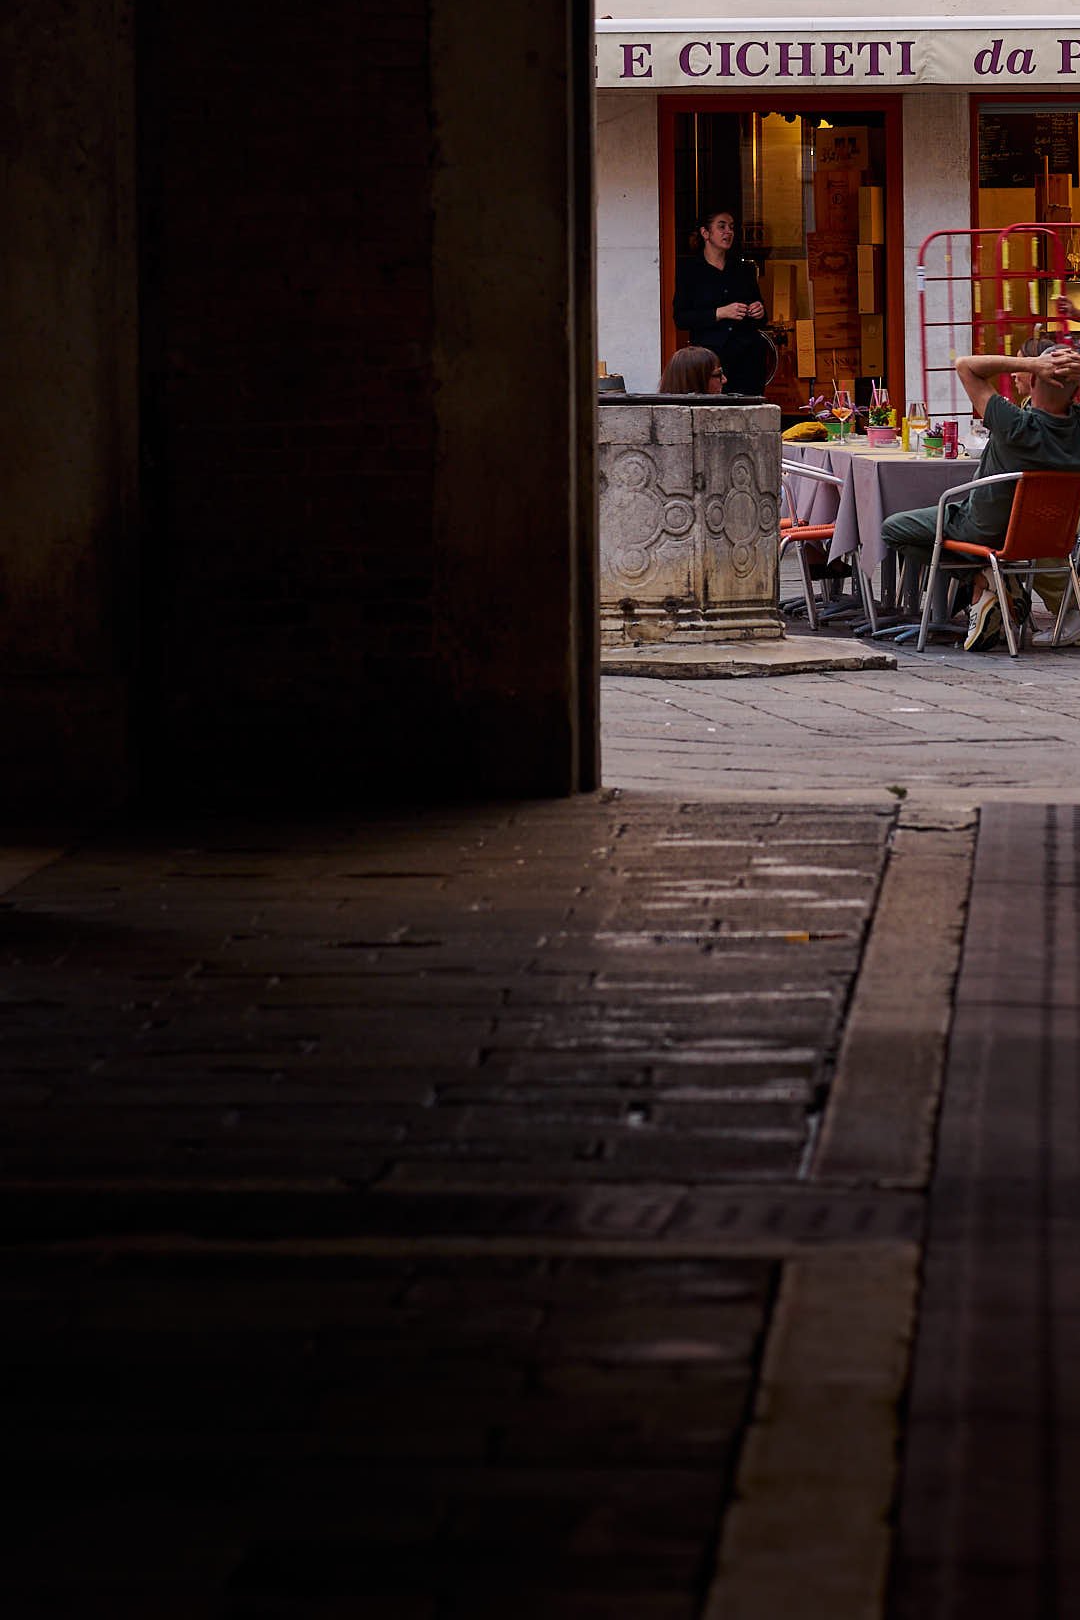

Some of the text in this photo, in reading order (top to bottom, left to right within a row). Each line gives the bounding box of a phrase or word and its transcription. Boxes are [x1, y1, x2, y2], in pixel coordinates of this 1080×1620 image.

[619, 43, 653, 78] E
[679, 41, 916, 77] CICHETI
[974, 39, 1036, 75] da
